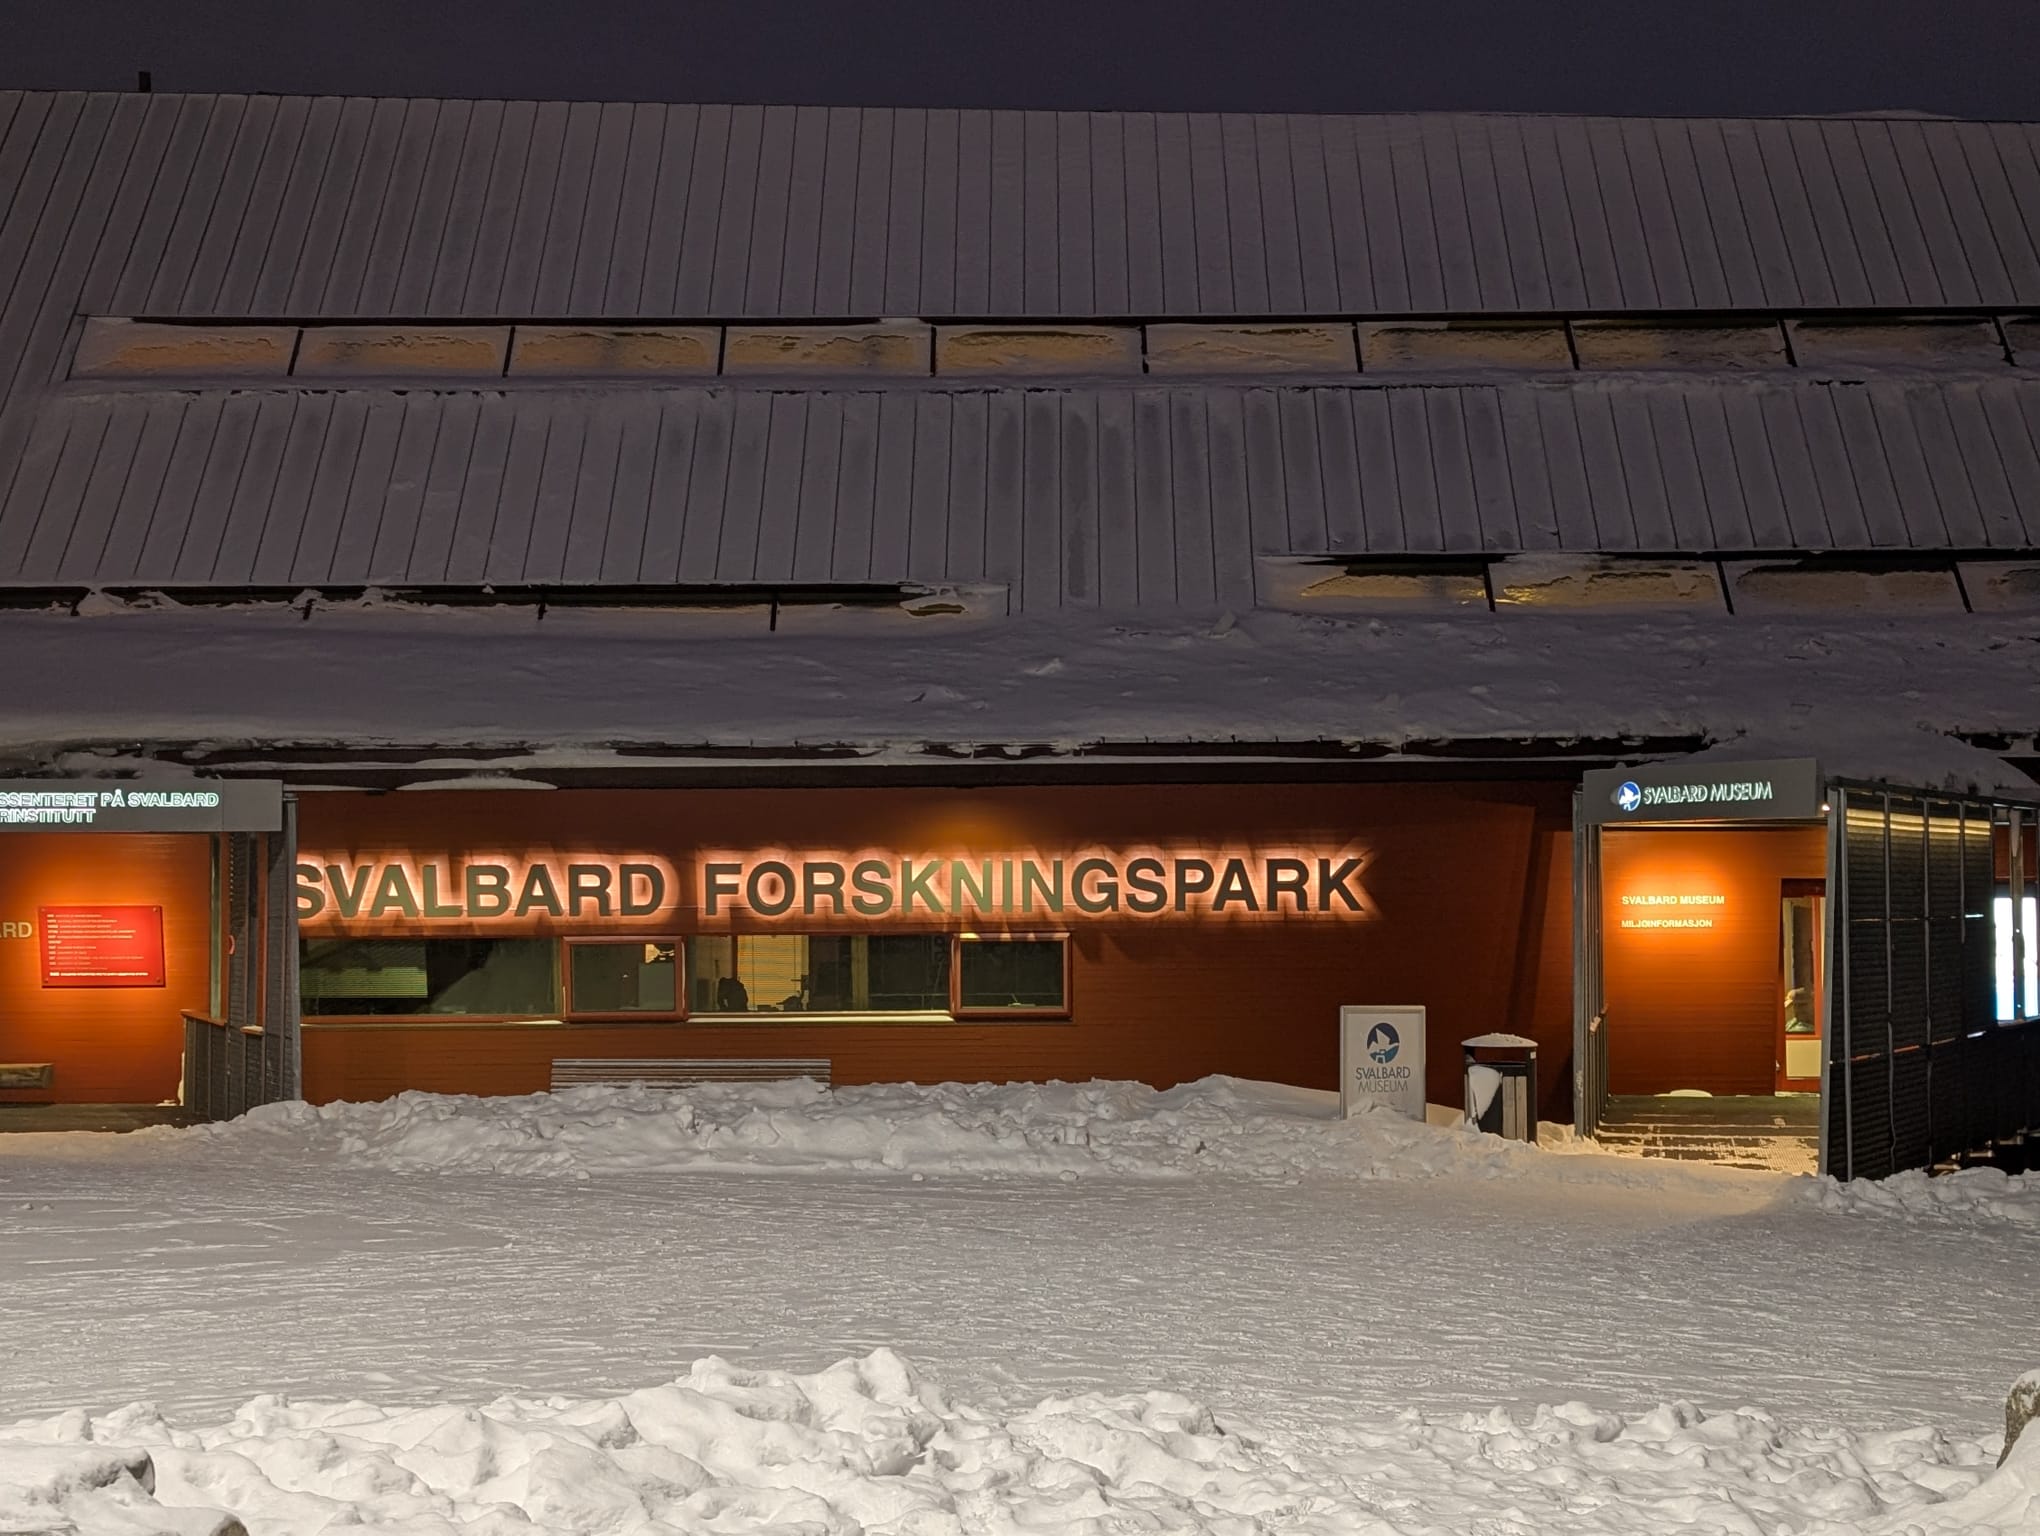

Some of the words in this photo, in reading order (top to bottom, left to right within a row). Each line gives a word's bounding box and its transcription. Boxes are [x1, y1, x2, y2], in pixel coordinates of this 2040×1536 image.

[100, 788, 126, 807] PÅ
[127, 792, 219, 807] SVALBARD
[1643, 784, 1708, 804] SVALBARD
[1710, 781, 1773, 802] MUSEUM
[296, 863, 665, 919] SVALBARD
[705, 858, 1364, 917] FORSKNINGSPARK
[1622, 895, 1677, 905] SVALBARD
[1679, 895, 1725, 905] MUSEUM
[0, 921, 33, 938] RD
[1355, 1066, 1411, 1080] SVALBARD
[1358, 1080, 1409, 1093] MUSEUM
